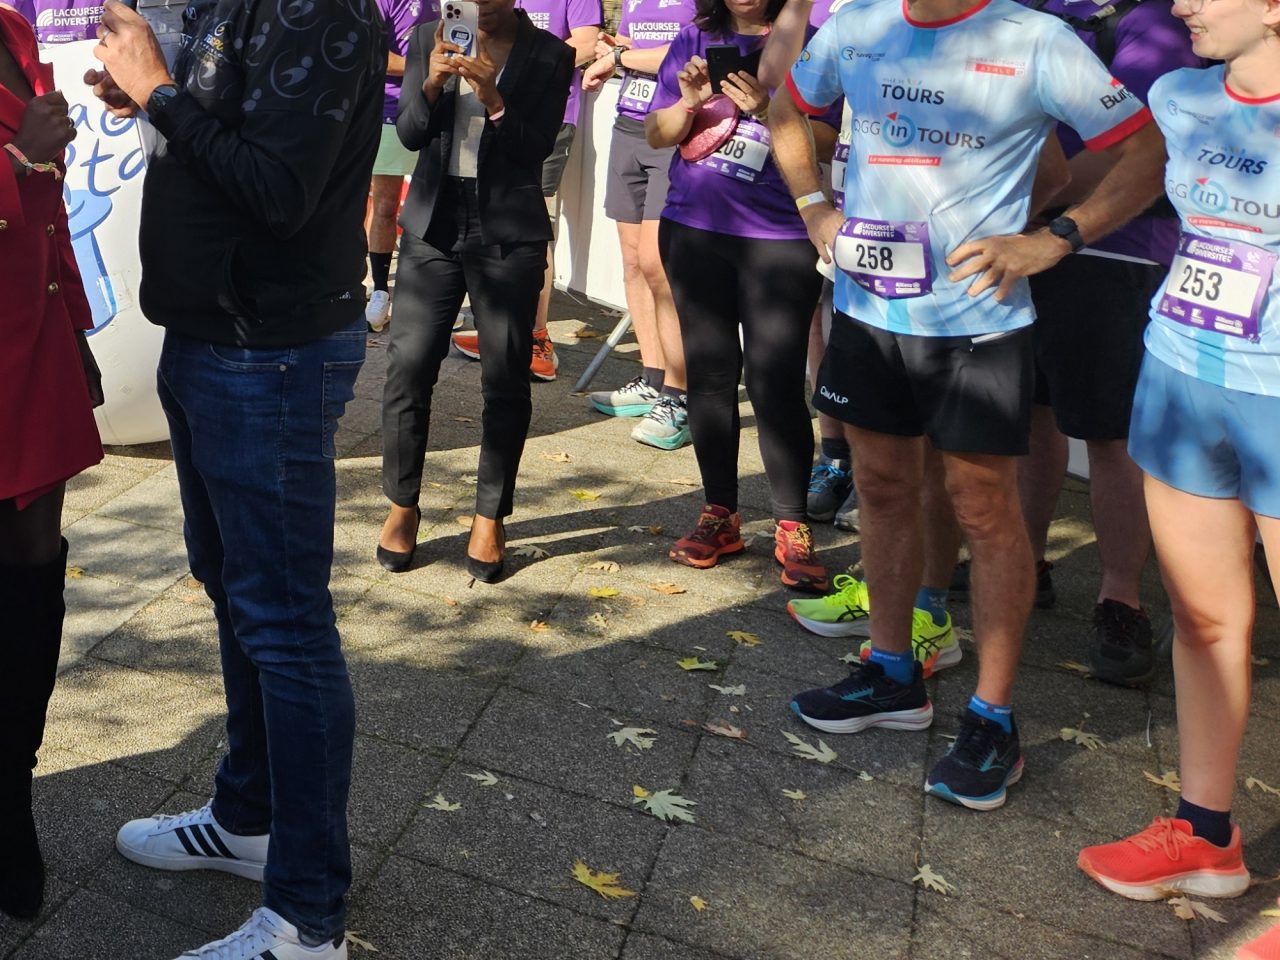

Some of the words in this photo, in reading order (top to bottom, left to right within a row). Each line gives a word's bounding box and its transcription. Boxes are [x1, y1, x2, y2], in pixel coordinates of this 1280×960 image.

[630, 81, 650, 98] 216
[881, 84, 945, 105] TOURS
[718, 139, 746, 160] 08
[891, 126, 908, 138] in
[917, 128, 986, 150] TOURS
[1197, 149, 1268, 175] TOURS
[1199, 191, 1219, 206] in
[1230, 196, 1280, 219] TOU
[856, 243, 894, 271] 258
[1179, 264, 1223, 302] 253
